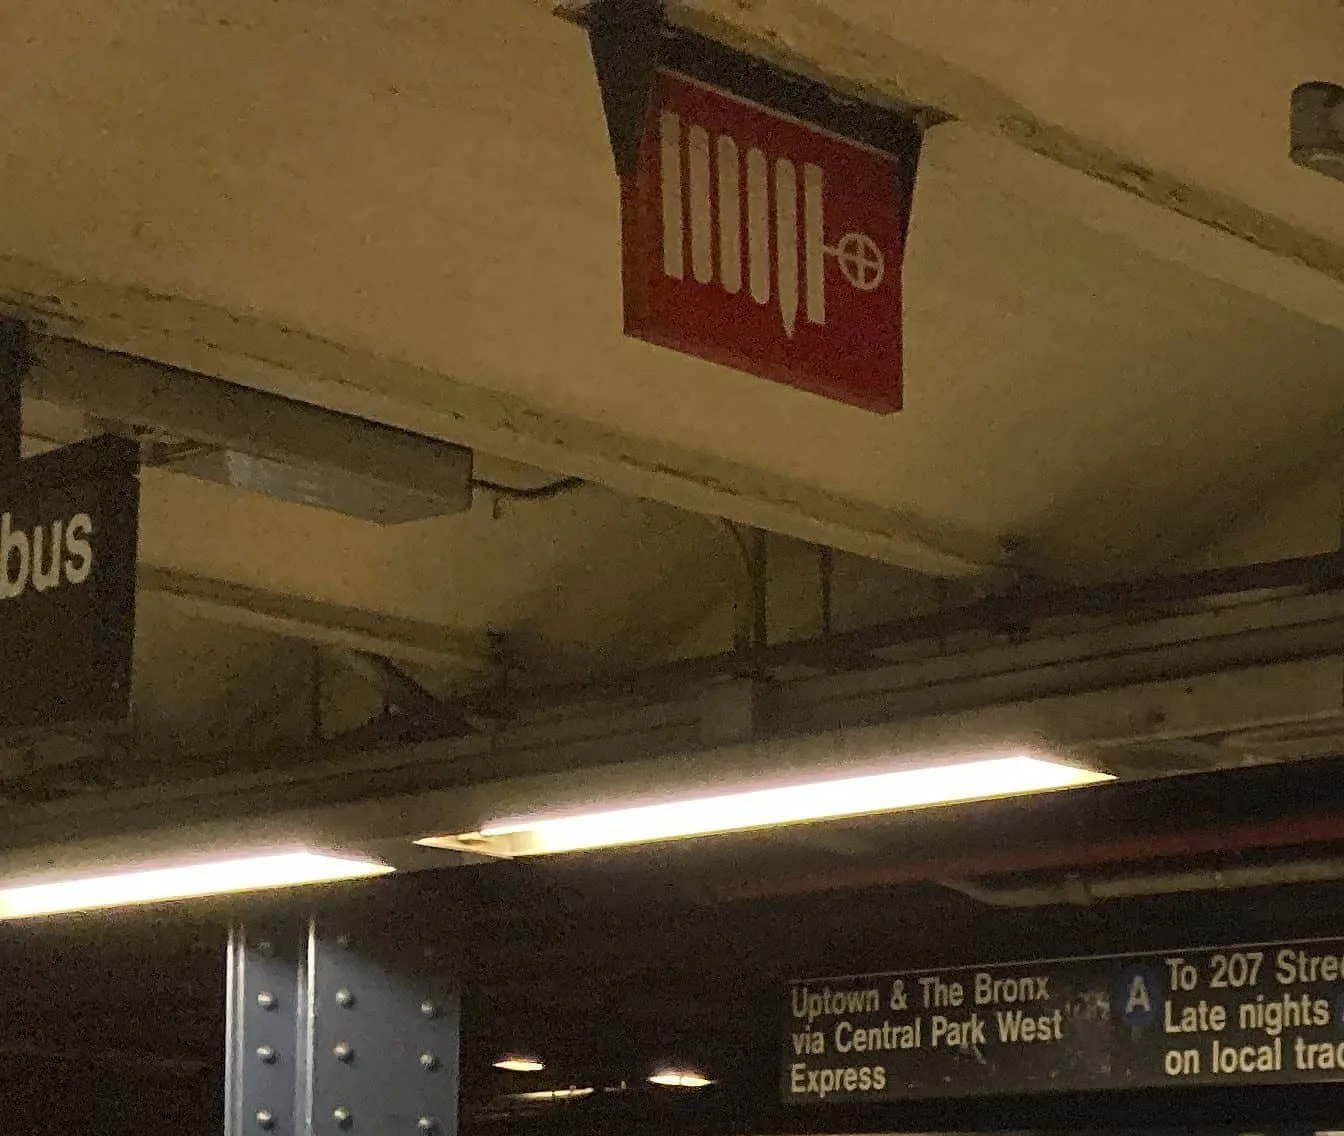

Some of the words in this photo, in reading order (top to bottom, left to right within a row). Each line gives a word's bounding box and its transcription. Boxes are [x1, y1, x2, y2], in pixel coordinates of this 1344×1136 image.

[0, 511, 93, 599] bus
[1165, 958, 1197, 991] To
[1210, 953, 1263, 988] 207
[791, 985, 879, 1023] Uptown
[890, 979, 907, 1011] &
[918, 976, 964, 1008] The
[975, 973, 1050, 1007] Bronx
[1126, 976, 1151, 1014] A
[1165, 1000, 1227, 1034] Late
[1240, 993, 1330, 1036] nights
[792, 1027, 824, 1056] via
[835, 1016, 921, 1054] Central
[932, 1012, 986, 1048] Park
[998, 1010, 1063, 1043] West
[1165, 1048, 1199, 1076] on
[1213, 1037, 1280, 1073] local
[790, 1063, 886, 1098] Express
